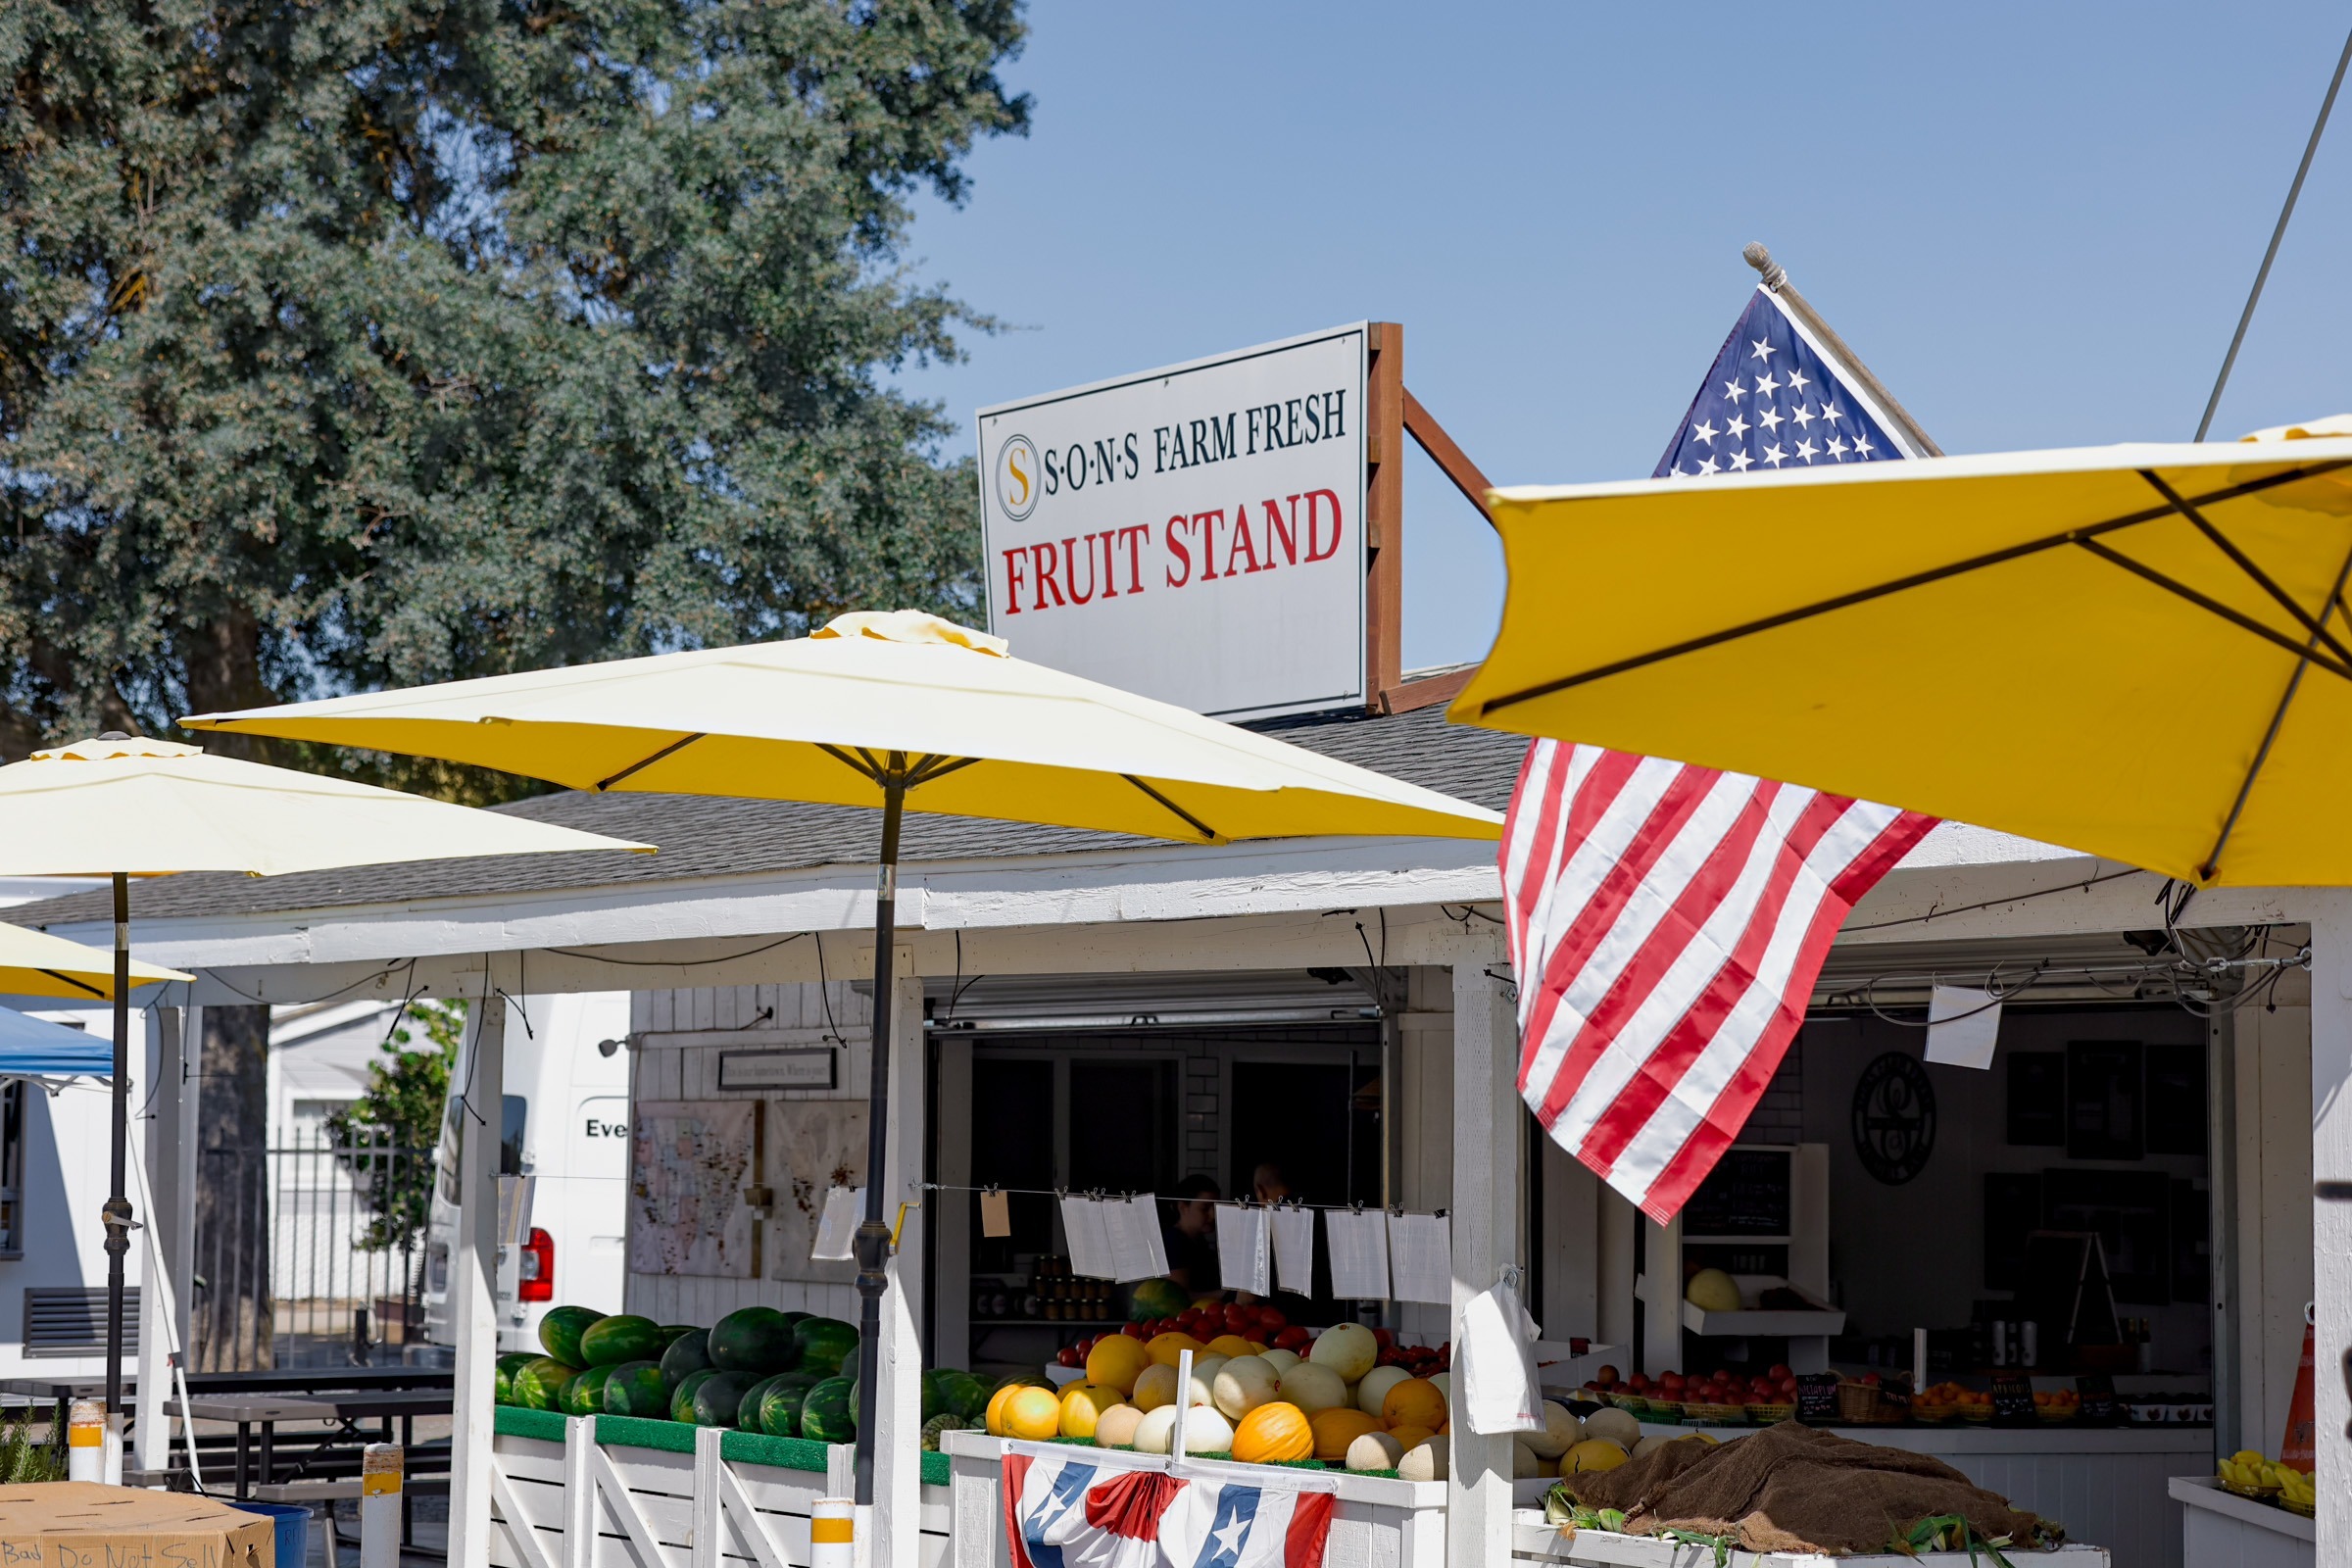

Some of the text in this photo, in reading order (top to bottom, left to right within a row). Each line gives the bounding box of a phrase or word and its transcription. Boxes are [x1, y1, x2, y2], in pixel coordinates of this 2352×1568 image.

[1153, 412, 1238, 473] FARM
[1246, 389, 1348, 456] FRESH
[1007, 447, 1030, 507] S
[1002, 488, 1343, 615] FRUIT STAND
[1, 1540, 218, 1568] Bad Do Not Sell
